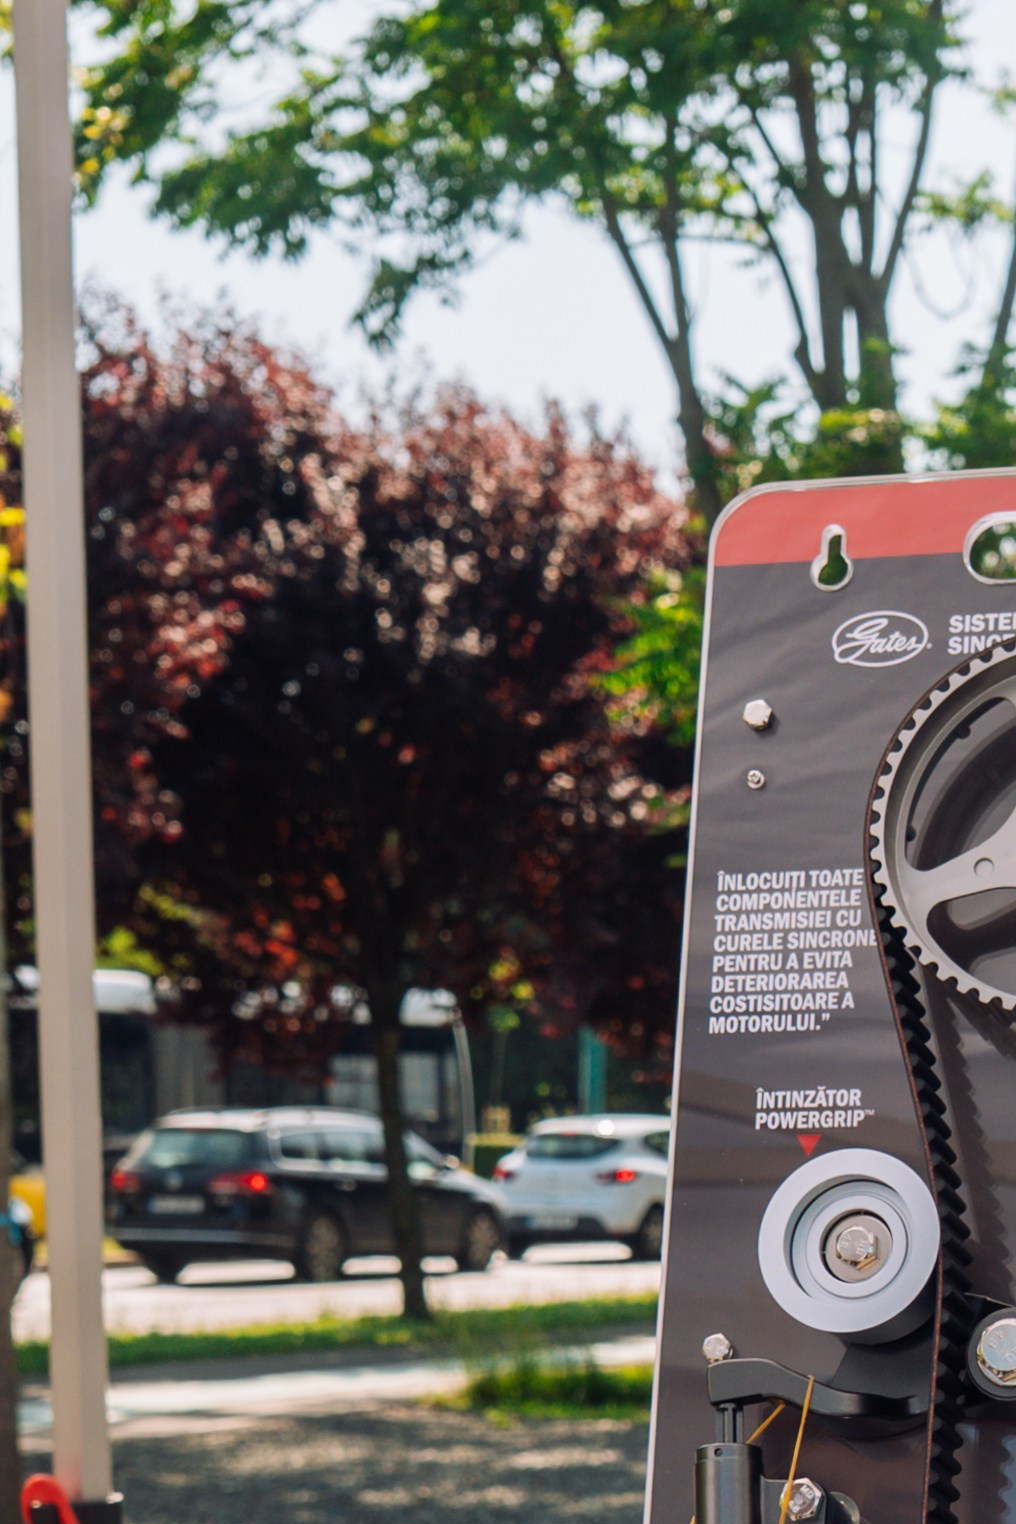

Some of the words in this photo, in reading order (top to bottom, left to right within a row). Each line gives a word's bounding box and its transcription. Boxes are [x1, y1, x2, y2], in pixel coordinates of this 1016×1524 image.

[947, 633, 1016, 655] SINC
[809, 868, 864, 888] TOATE
[715, 889, 862, 912] COMPONENTELE
[714, 911, 832, 932] TRANSMISIEI
[836, 909, 862, 928] CU
[713, 932, 785, 953] CURELE
[787, 929, 878, 950] SINCRONE
[712, 953, 783, 973] PENTRU
[785, 954, 799, 970] A
[802, 951, 853, 970] EVITA
[711, 971, 849, 993] DETERIORAREA
[709, 992, 839, 1014] COSTISITOARE
[841, 992, 855, 1009] A
[756, 1086, 862, 1109] ÎNTINZĂTOR
